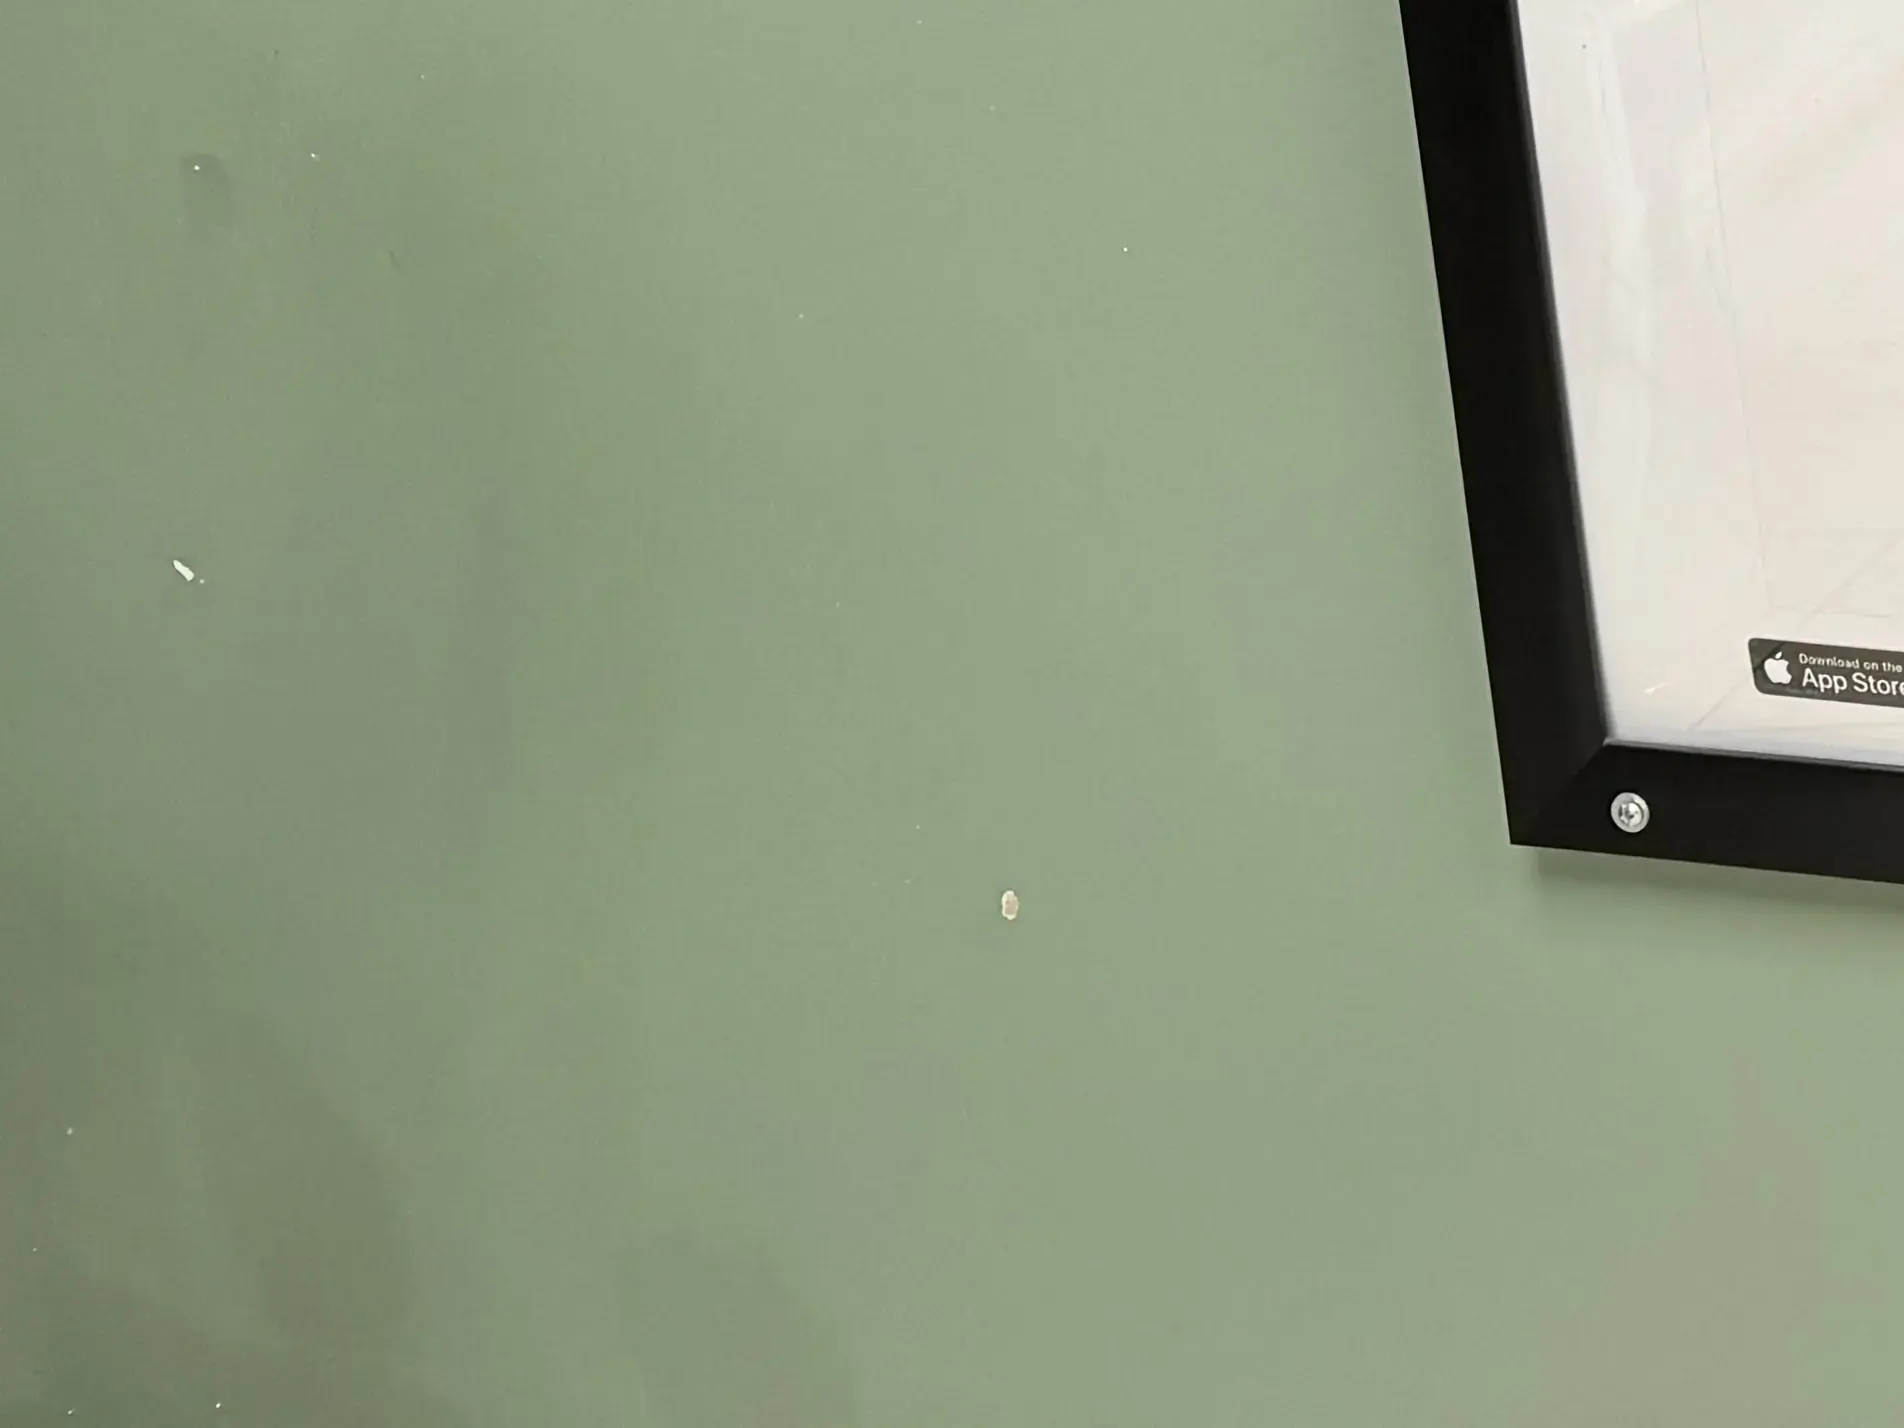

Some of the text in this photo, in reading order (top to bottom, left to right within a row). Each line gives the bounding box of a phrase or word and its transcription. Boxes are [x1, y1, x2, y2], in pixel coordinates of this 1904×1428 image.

[1799, 653, 1903, 673] Download on the
[1802, 668, 1848, 694] App
